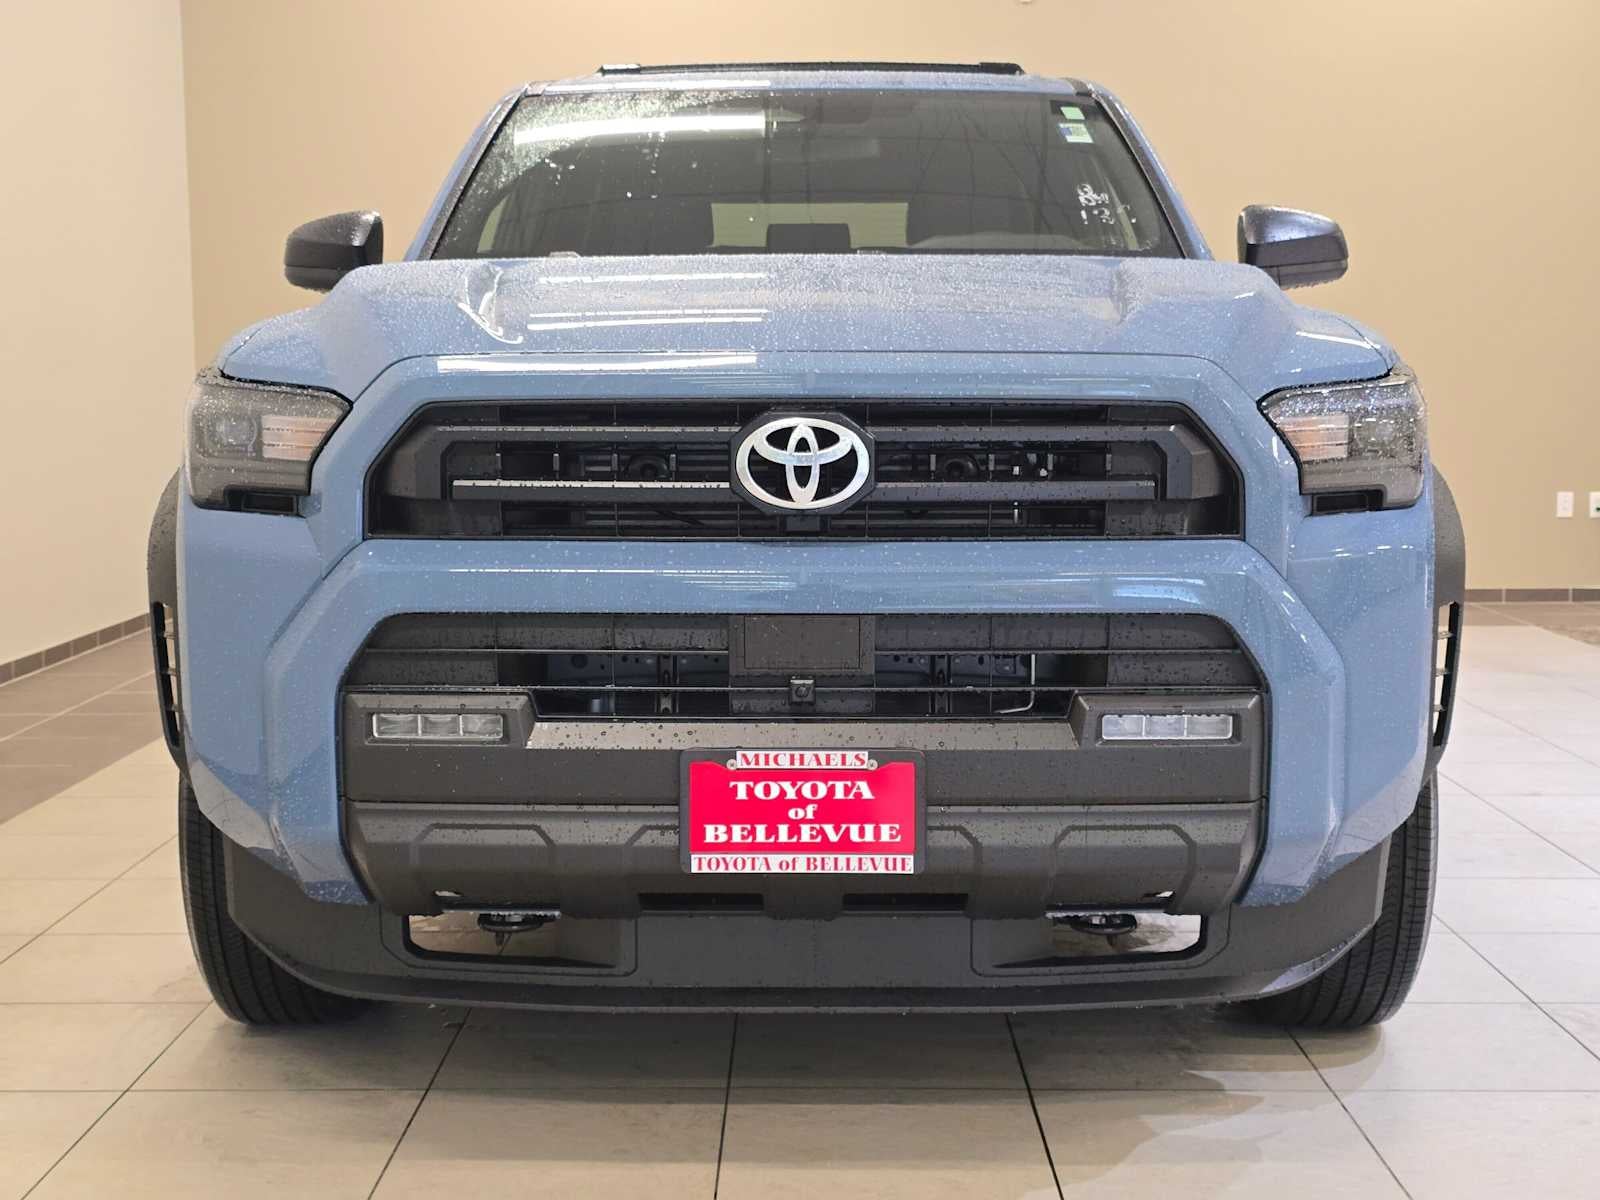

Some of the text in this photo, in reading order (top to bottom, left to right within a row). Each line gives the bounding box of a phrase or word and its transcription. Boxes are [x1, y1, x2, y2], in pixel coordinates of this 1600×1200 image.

[739, 753, 867, 767] MICHAELS
[729, 781, 875, 800] TOYOTA
[788, 804, 818, 820] of
[704, 824, 901, 844] BELLEVUE
[693, 857, 912, 872] TOYOTA of BELLEVUE
